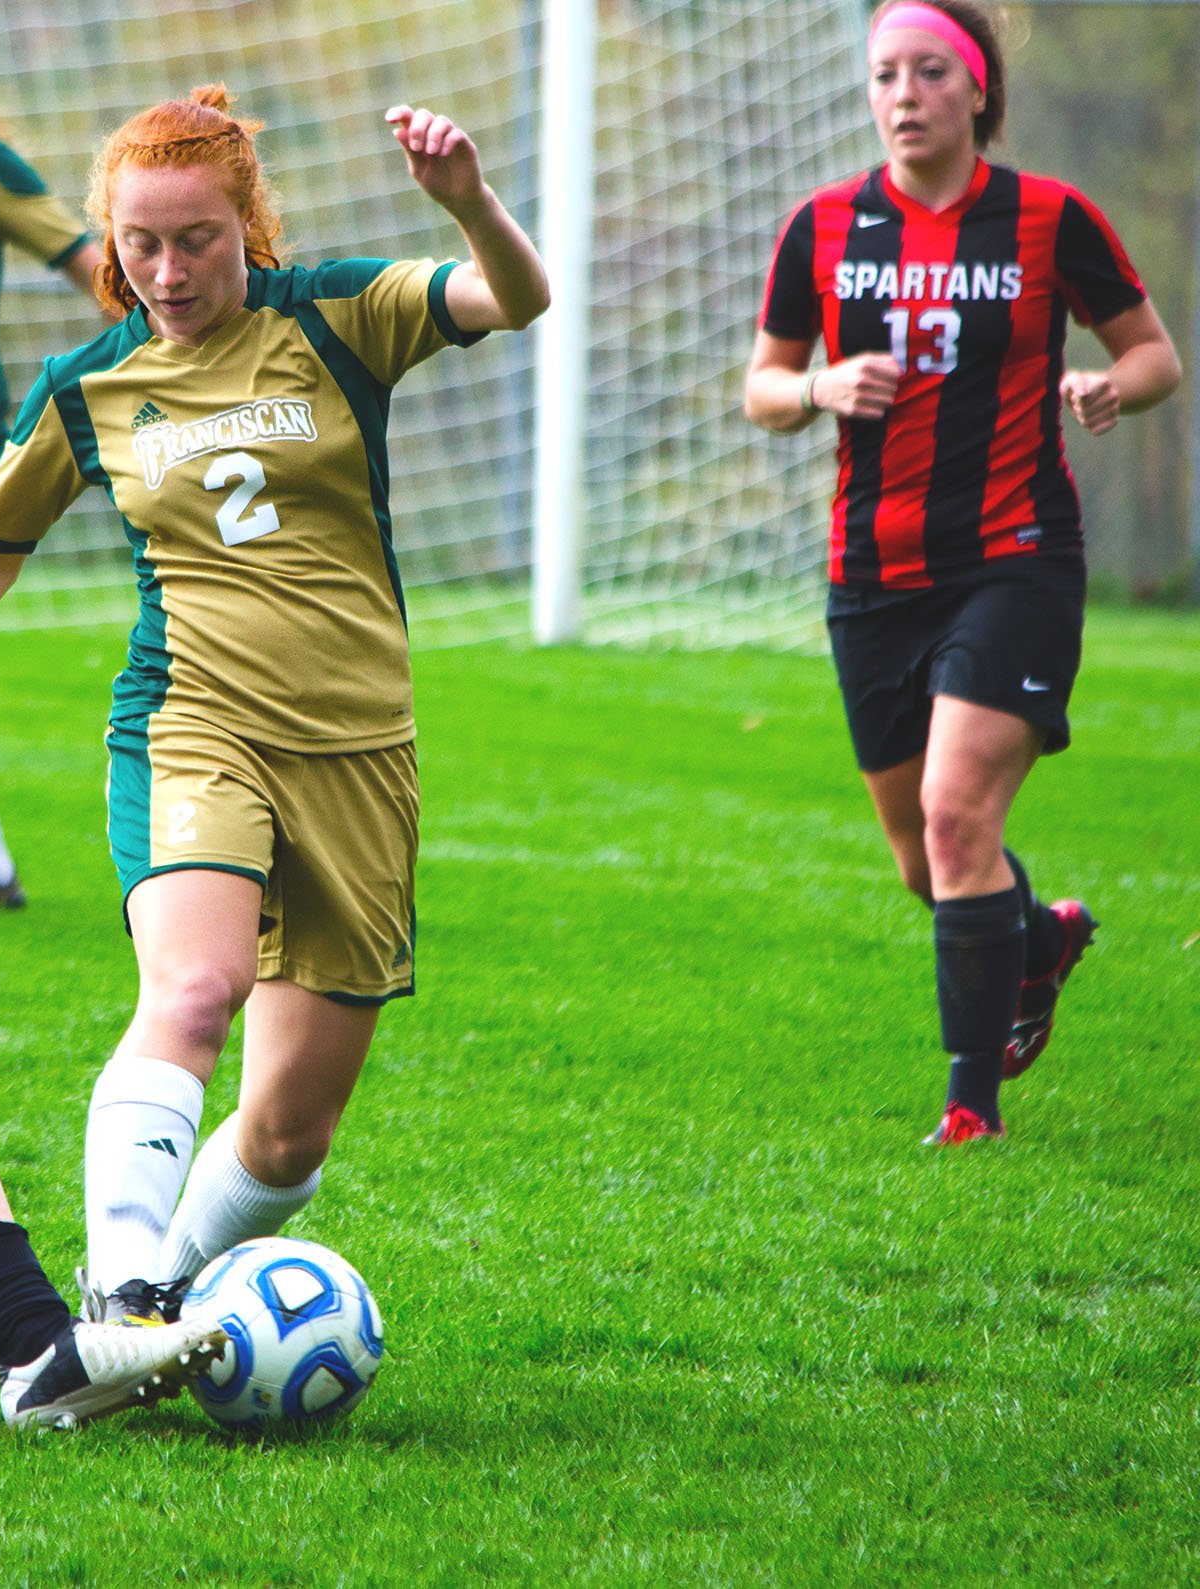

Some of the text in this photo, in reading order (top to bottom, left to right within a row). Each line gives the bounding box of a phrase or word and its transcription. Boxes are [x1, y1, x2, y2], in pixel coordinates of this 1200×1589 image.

[835, 262, 1022, 299] SPARTANS
[883, 308, 961, 374] 13
[131, 413, 168, 429] adidas
[133, 400, 317, 489] FRANCISCAN
[203, 452, 280, 547] 2
[167, 803, 196, 843] 2
